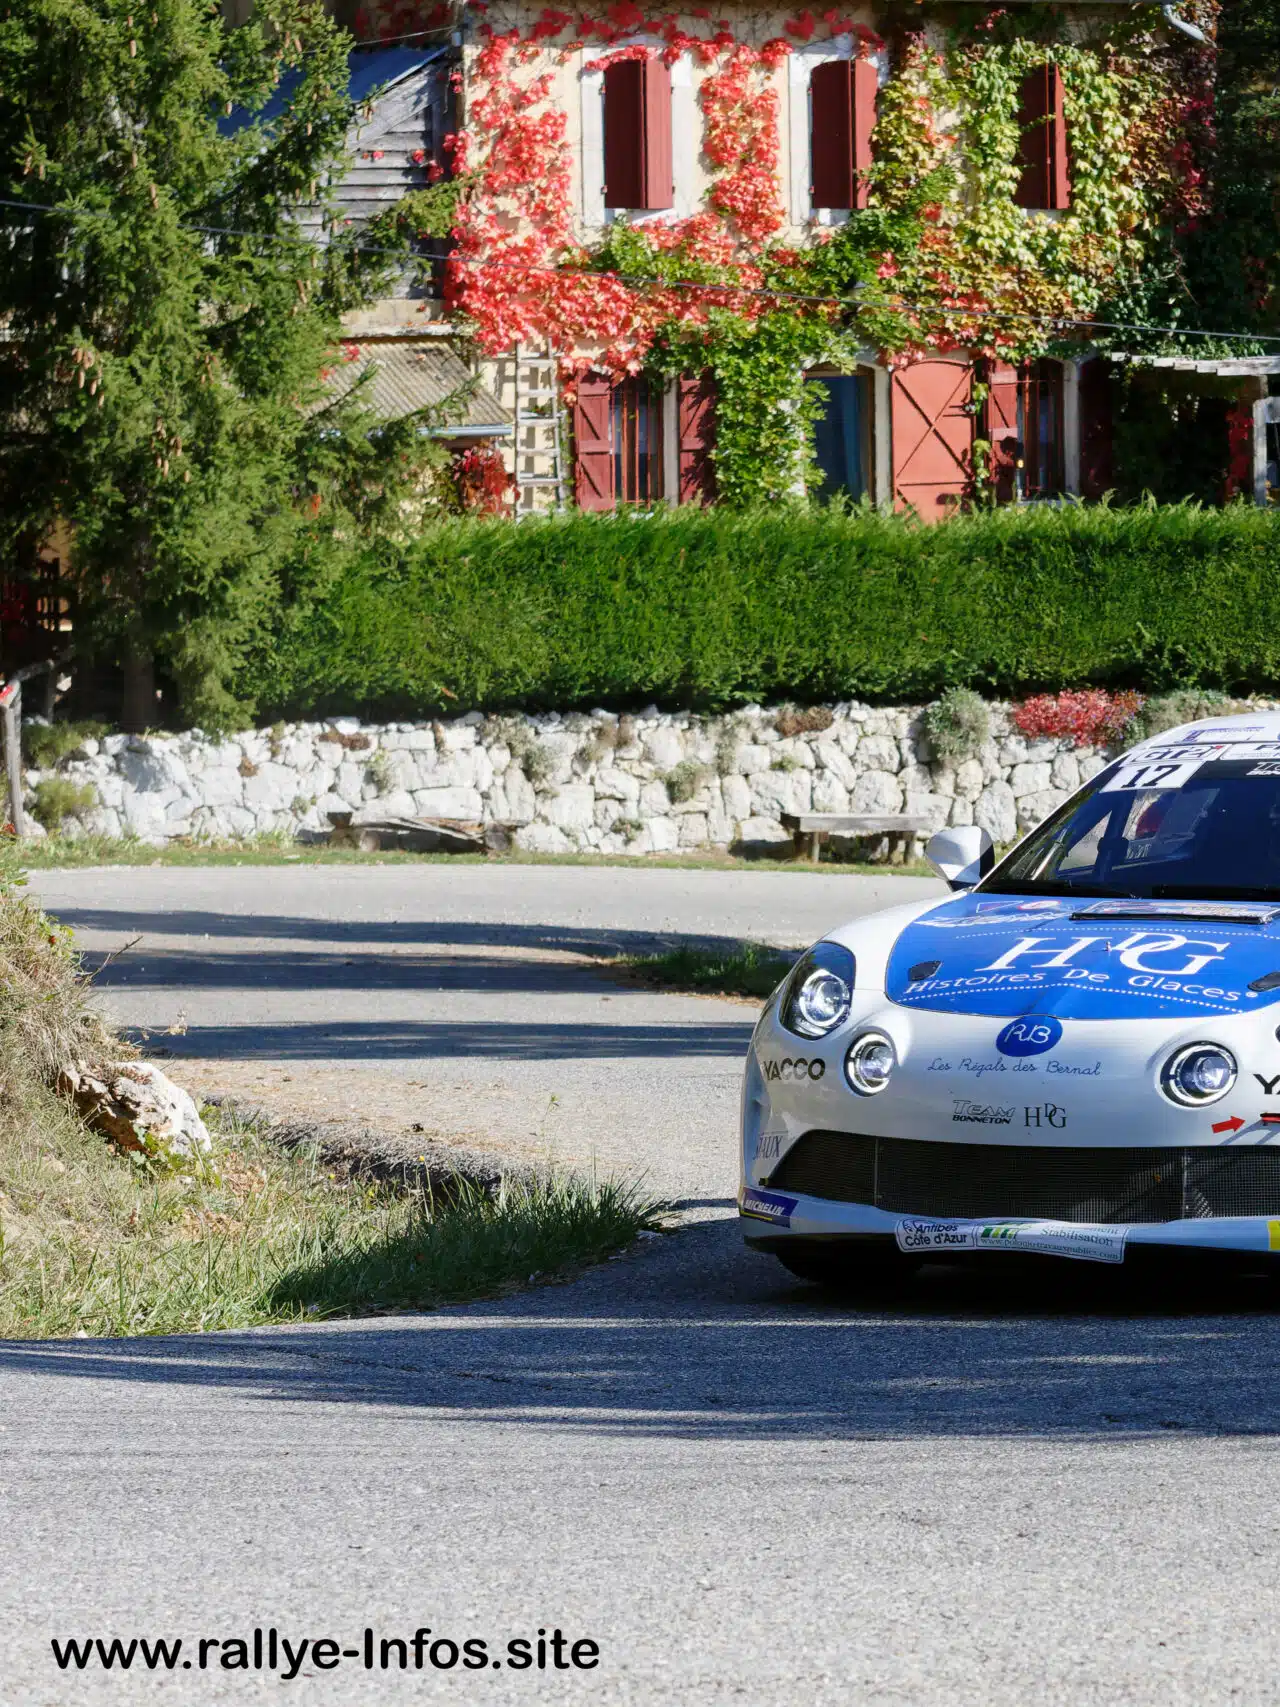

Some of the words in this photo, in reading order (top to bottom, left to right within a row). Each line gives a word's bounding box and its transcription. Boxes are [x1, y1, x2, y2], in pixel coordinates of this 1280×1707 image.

[1121, 764, 1183, 789] 17
[904, 969, 1045, 996] Histoires
[1061, 967, 1111, 983] De
[1005, 1022, 1051, 1045] RB
[762, 1057, 826, 1082] YACCO
[928, 1057, 952, 1072] Les
[958, 1057, 1008, 1078] Régals
[1013, 1058, 1037, 1072] des
[1045, 1060, 1102, 1076] Bernal
[952, 1100, 1016, 1118] TEAM
[952, 1115, 1012, 1125] BONNETON
[745, 1199, 785, 1216] MICHELIN
[916, 1222, 959, 1234] Antibes
[935, 1231, 968, 1245] d'Azur
[1040, 1227, 1114, 1247] Stabilisation
